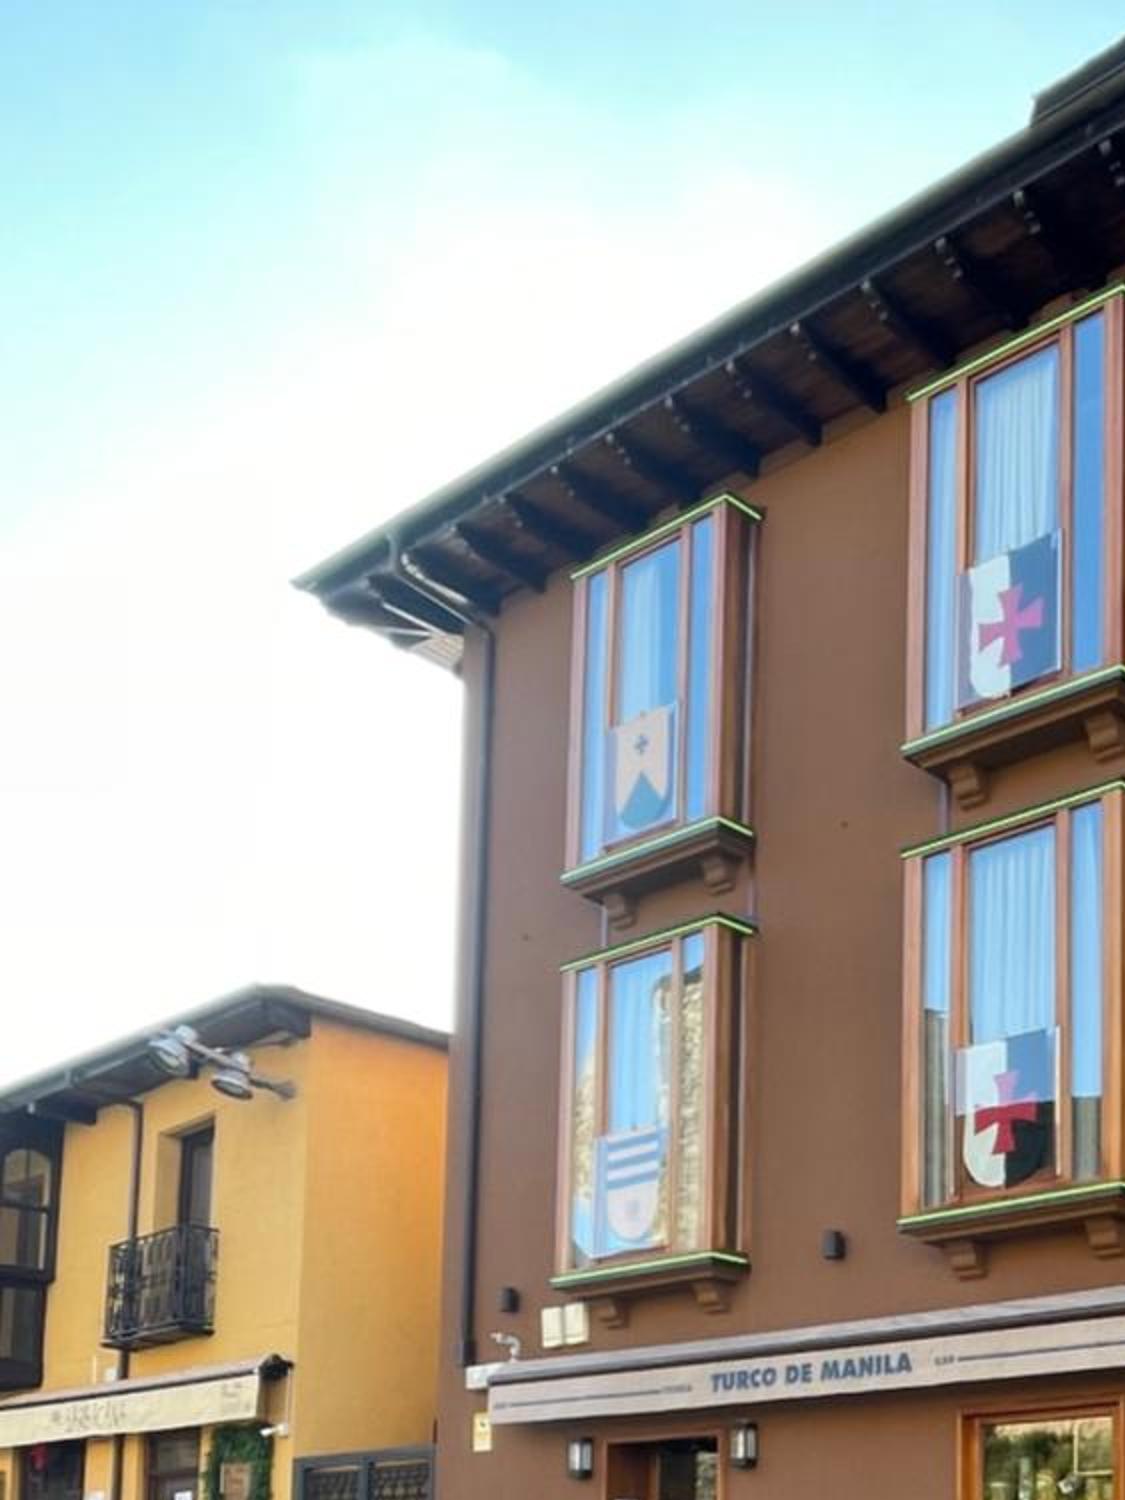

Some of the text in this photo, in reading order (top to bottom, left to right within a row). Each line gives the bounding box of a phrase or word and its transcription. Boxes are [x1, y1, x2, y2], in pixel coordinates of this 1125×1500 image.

[711, 1366, 777, 1392] TURCO
[785, 1363, 813, 1384] DE
[820, 1352, 912, 1381] MANILA
